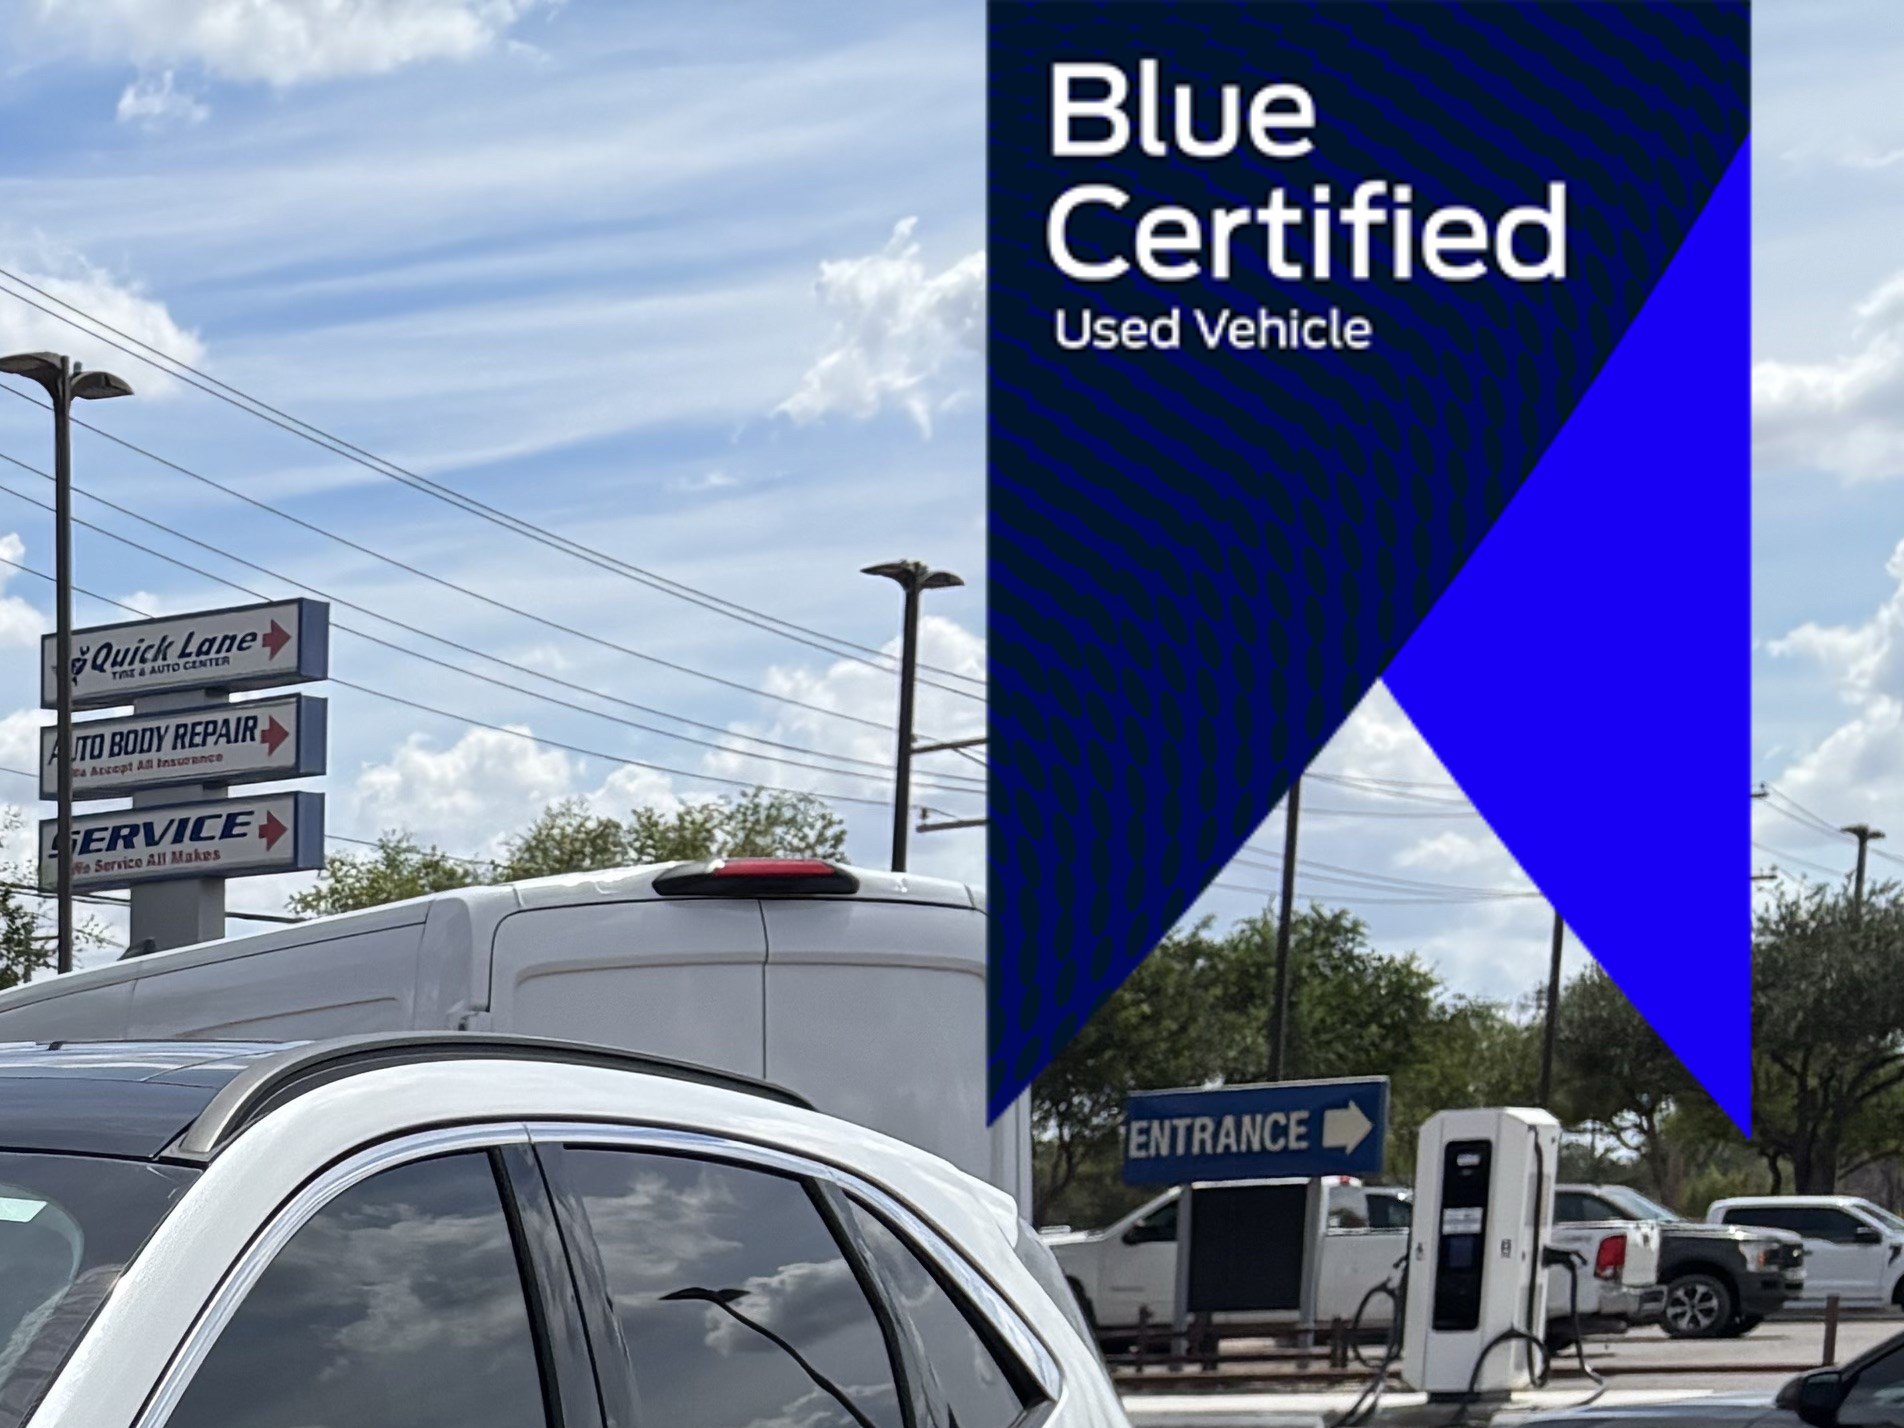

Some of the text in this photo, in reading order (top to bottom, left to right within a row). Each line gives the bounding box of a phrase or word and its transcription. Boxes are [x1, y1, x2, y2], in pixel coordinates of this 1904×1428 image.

[91, 630, 258, 673] Quick Lane
[149, 662, 181, 675] AUTO
[108, 724, 170, 758] BODY
[171, 715, 258, 751] REPAIR
[48, 810, 255, 859] SERVICE
[146, 852, 166, 867] All
[1128, 1109, 1311, 1160] ENTRANCE
